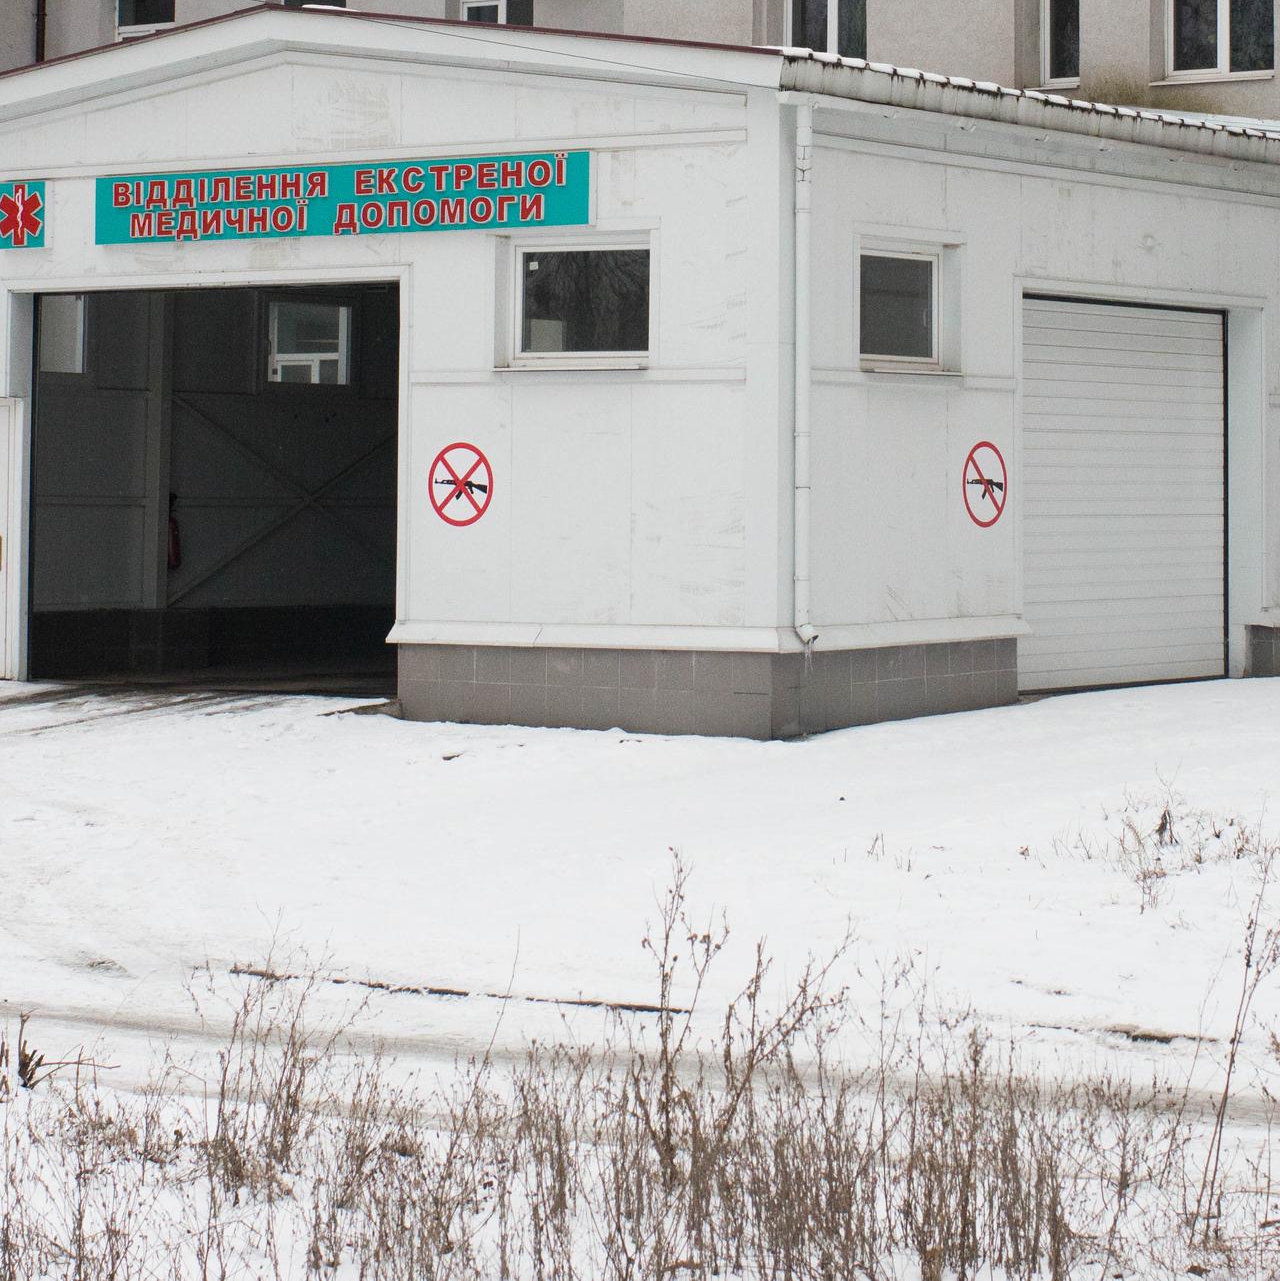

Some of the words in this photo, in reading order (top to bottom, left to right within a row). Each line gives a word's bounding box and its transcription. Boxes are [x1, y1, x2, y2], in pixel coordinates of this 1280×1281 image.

[113, 171, 329, 210] ВІДДІЛЕННЯ
[355, 152, 567, 196] ЕКСТРЕНОЇ
[130, 199, 307, 241] МЕДИЧНОЇ
[333, 193, 544, 235] ДОПОМОГИ
